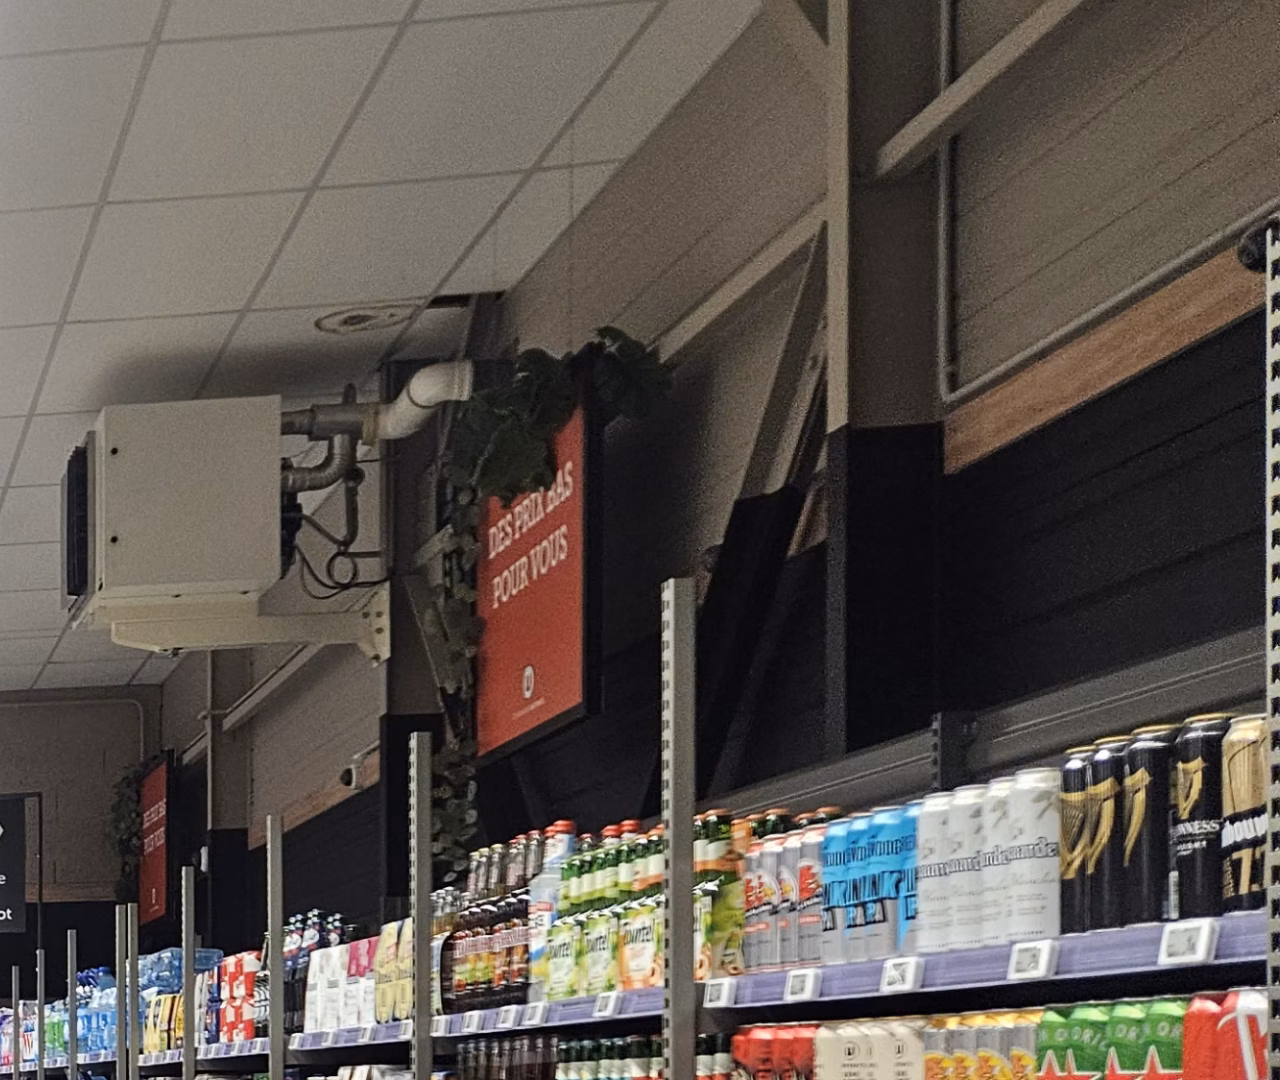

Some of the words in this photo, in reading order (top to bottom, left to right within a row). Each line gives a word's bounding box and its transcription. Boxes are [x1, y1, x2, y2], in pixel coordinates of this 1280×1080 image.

[488, 514, 513, 559] DES
[514, 486, 545, 541] PRIX
[492, 555, 530, 609] POUR
[530, 524, 569, 580] VOUS
